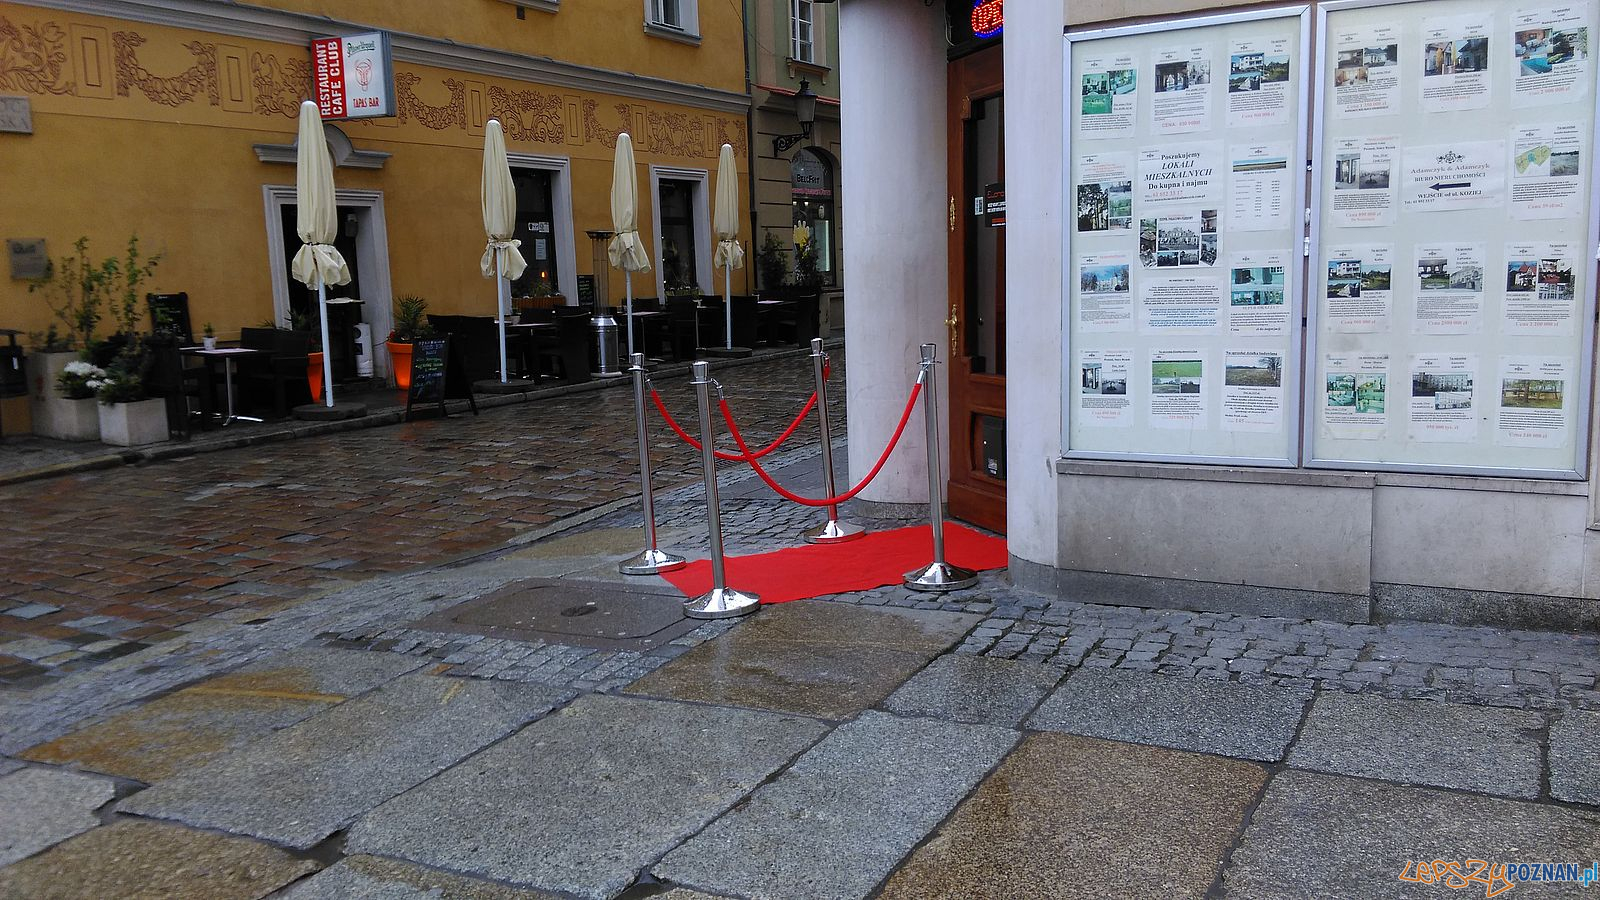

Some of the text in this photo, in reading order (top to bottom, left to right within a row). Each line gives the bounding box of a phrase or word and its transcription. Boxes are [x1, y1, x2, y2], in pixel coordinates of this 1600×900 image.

[316, 44, 331, 115] RESTAURANT
[328, 41, 342, 115] CAFE CLUB
[369, 97, 379, 107] BAR
[1161, 152, 1200, 160] Poszukujemy
[1162, 160, 1195, 169] LOKALI
[1411, 166, 1445, 174] Adamczyk
[1455, 163, 1490, 171] Adamczyk
[1144, 168, 1212, 181] MIESZKALNYCH
[1160, 182, 1180, 190] kupna
[1186, 180, 1208, 188] najmu
